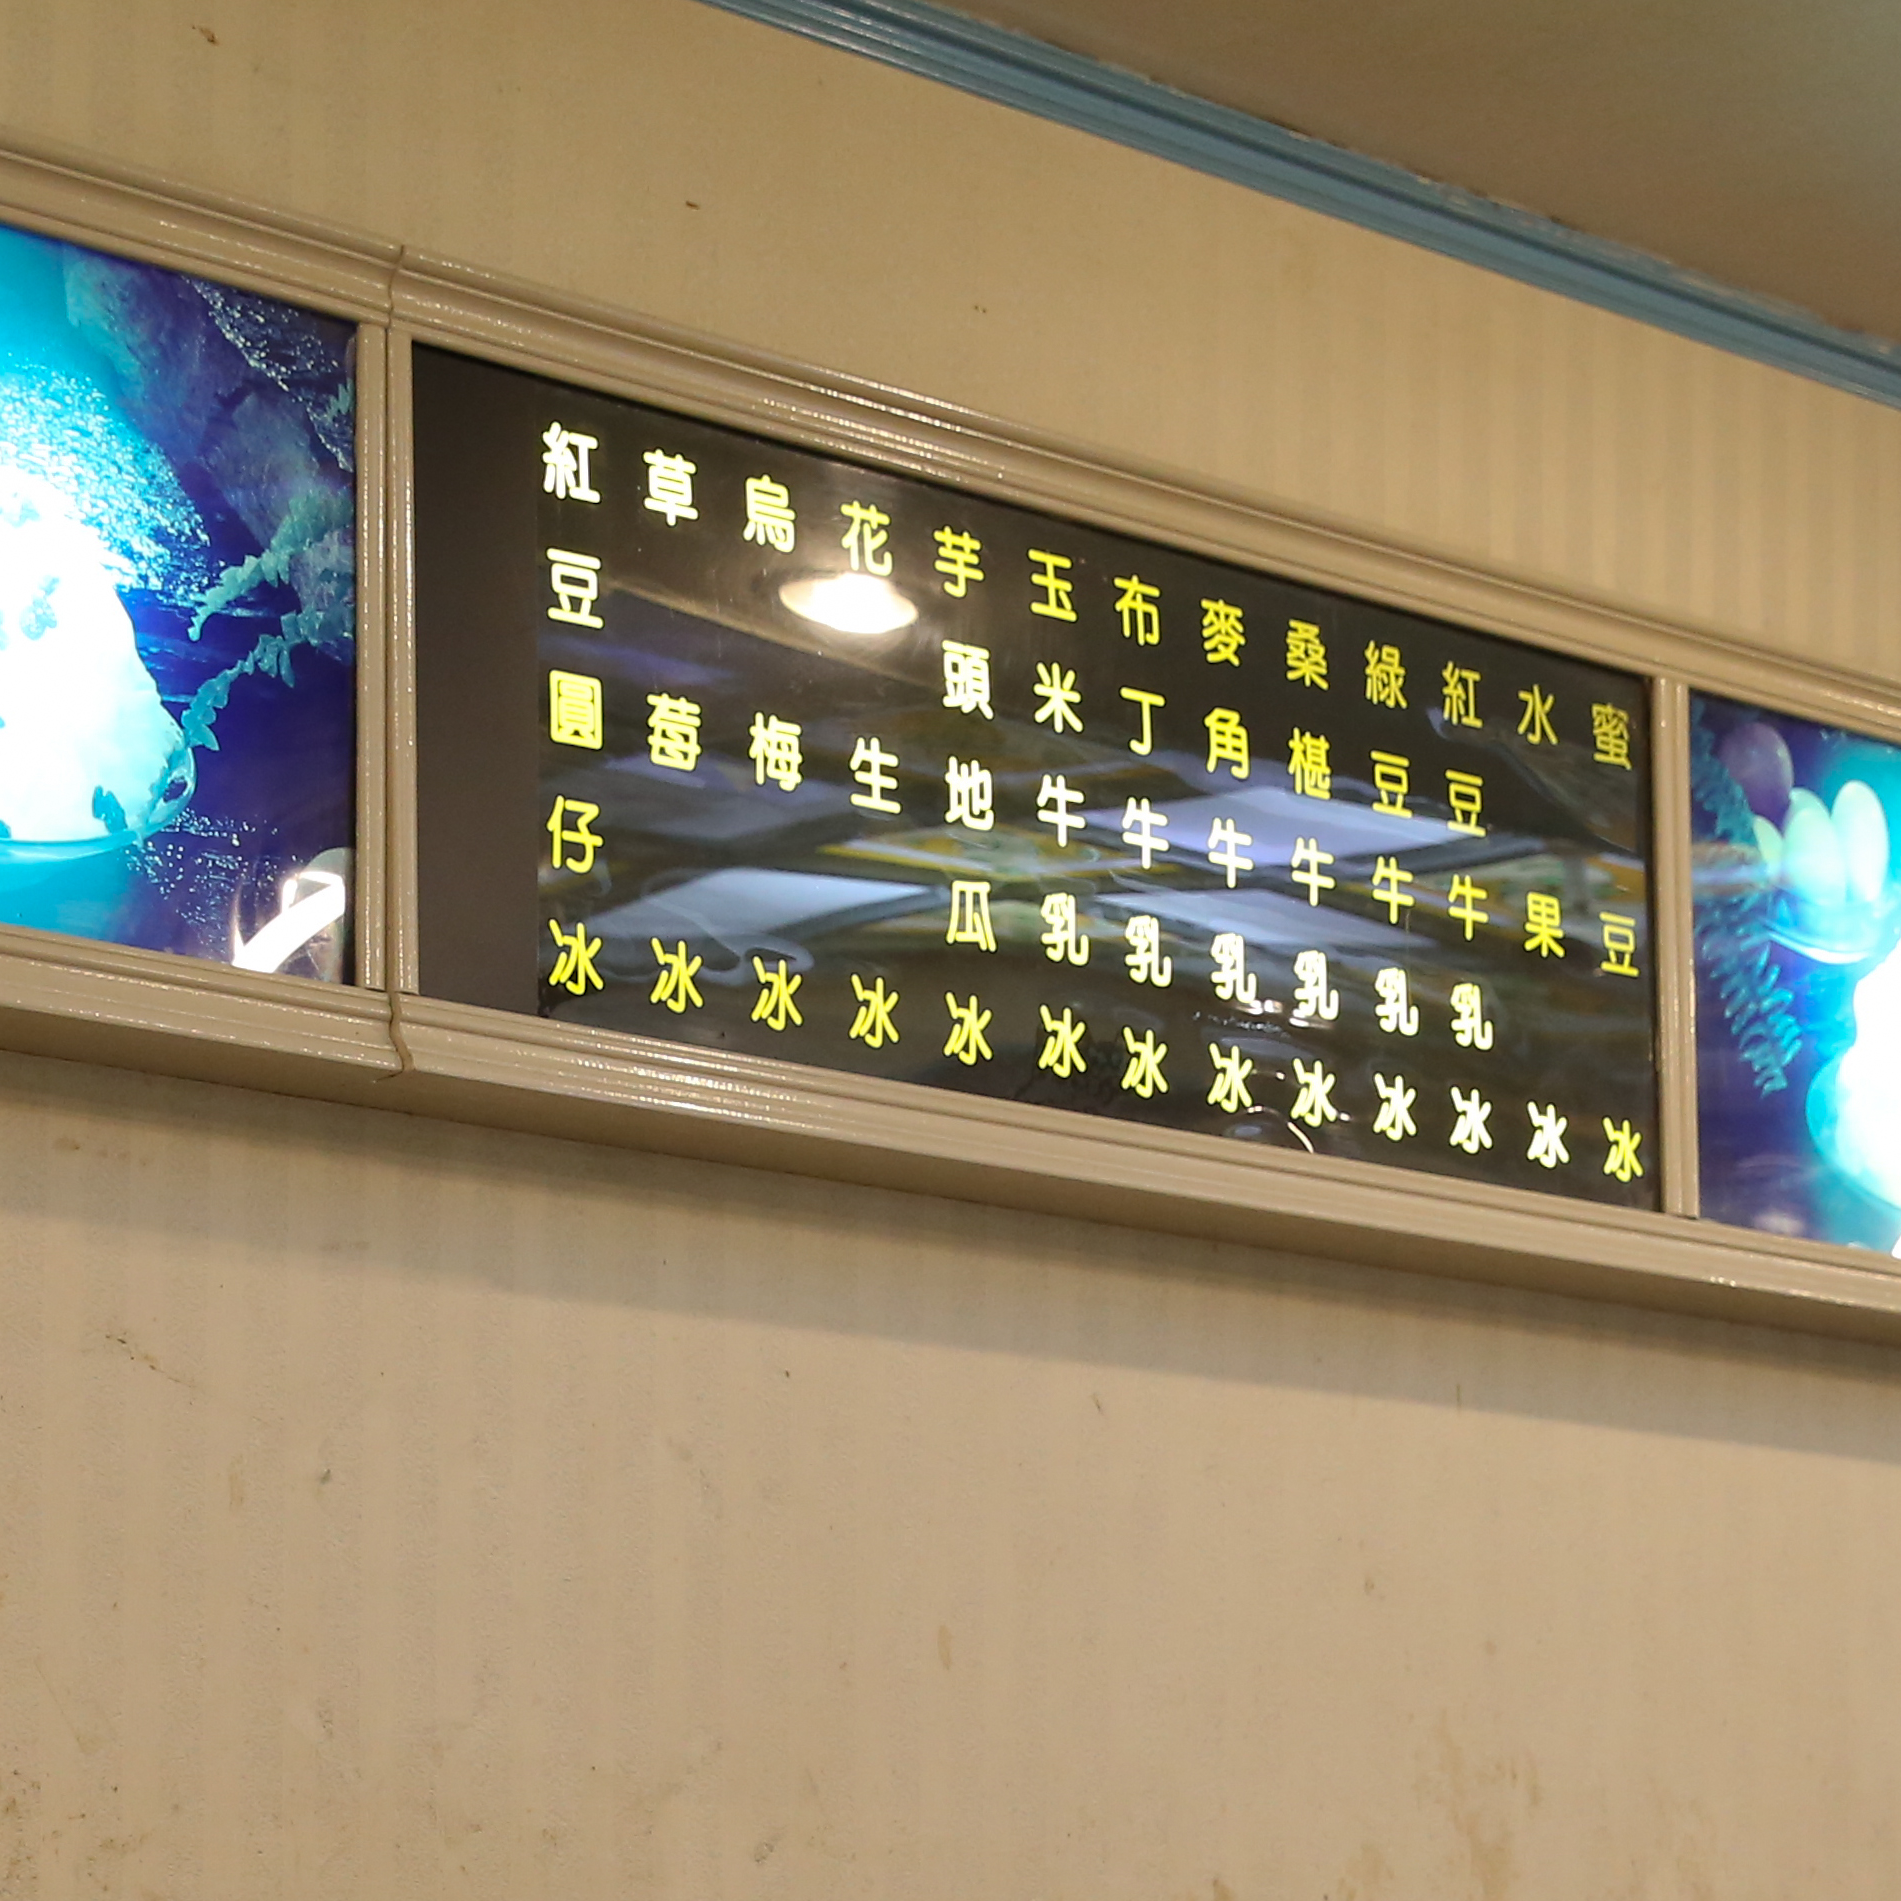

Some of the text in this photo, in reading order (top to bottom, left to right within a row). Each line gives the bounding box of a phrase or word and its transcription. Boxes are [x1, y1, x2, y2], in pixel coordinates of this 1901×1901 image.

[542, 422, 603, 995] 紅豆圓仔冰
[644, 449, 703, 1013] 草莓冰
[841, 501, 901, 1048] 花生冰
[934, 526, 996, 1065] 芋頭地瓜冰
[1028, 549, 1088, 1078] 玉米牛乳冰
[1114, 575, 1171, 1098] 布丁牛乳冰
[1201, 598, 1256, 1113] 麥角牛乳冰
[1363, 640, 1418, 1141] 綠豆牛乳冰
[1441, 661, 1493, 1154] 紅豆牛乳冰
[1517, 684, 1569, 1168] 水果冰
[1591, 703, 1643, 1182] 蜜豆冰
